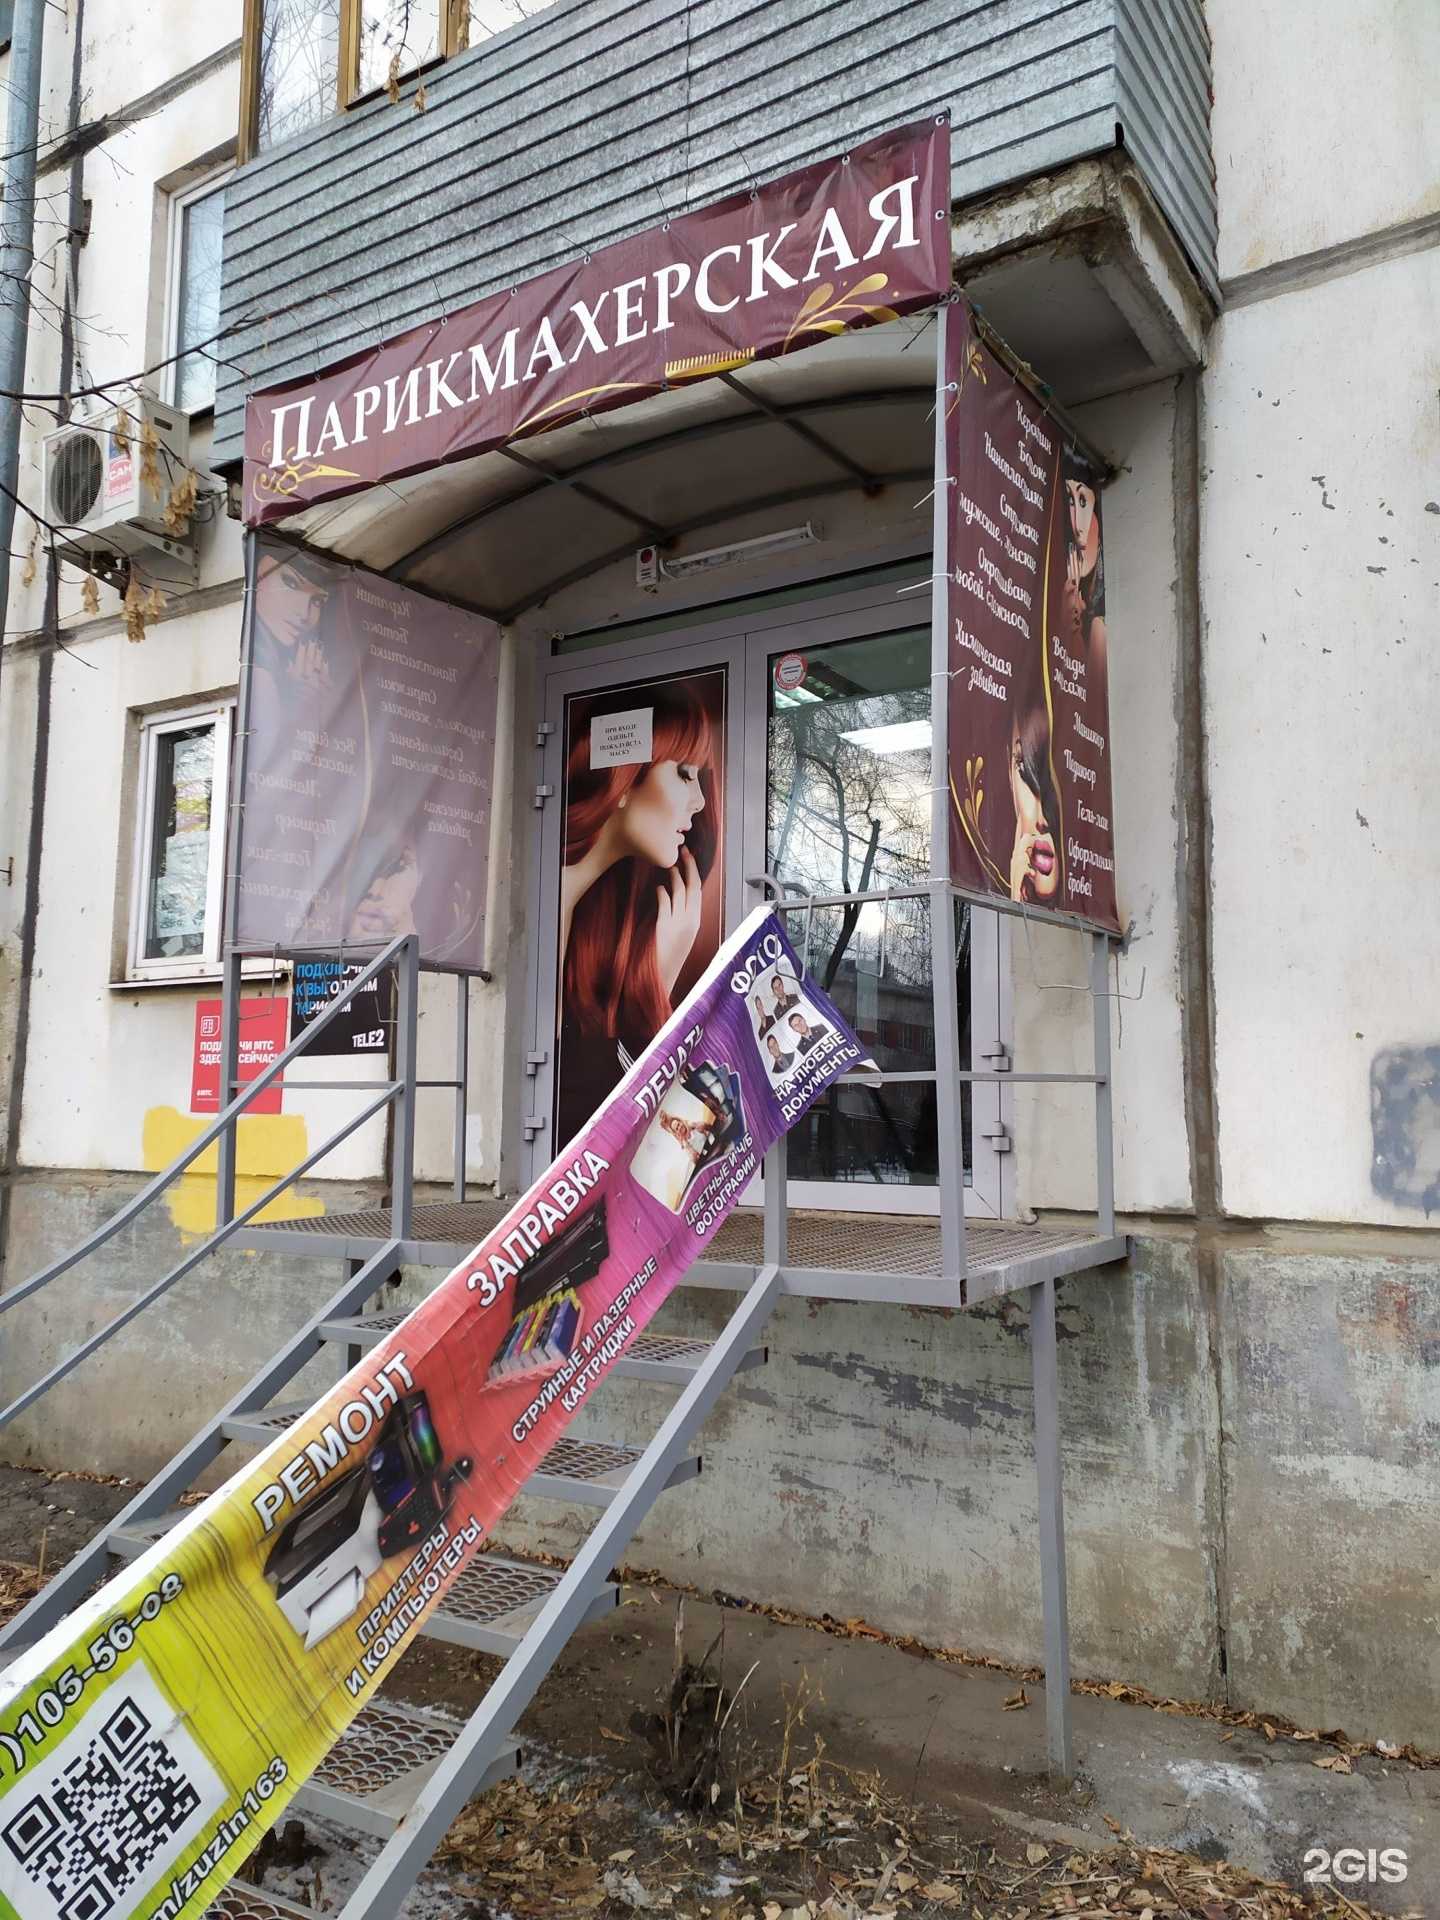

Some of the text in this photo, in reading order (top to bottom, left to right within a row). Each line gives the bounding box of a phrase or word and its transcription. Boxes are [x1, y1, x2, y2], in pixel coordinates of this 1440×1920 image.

[267, 175, 921, 468] ПАРИКМАХЕРСКАЯ
[968, 665, 1007, 701] завивка
[253, 1040, 274, 1050] МТС
[352, 1028, 385, 1048] TELE2
[773, 1031, 848, 1102] НА ЛЮБЫЕ
[780, 1042, 862, 1122] ДОКУМЕНТЫ
[467, 1149, 611, 1307] ЗАПРАВКА
[685, 1159, 732, 1227] ЦВЕТНЫЕ
[695, 1155, 757, 1237] ФОТОГРАФИИ
[511, 1257, 659, 1443] СТРУЙНЫЕ И ЛАЗЕРНЫЕ
[560, 1316, 637, 1414] КАРТРИДЖИ
[251, 1350, 415, 1534] РЕМОНТ
[345, 1516, 483, 1697] И КОМПЬЮТЕРЫ
[356, 1522, 450, 1645] ПРИНТЕРЫ
[0, 1572, 186, 1774] )105-56-08
